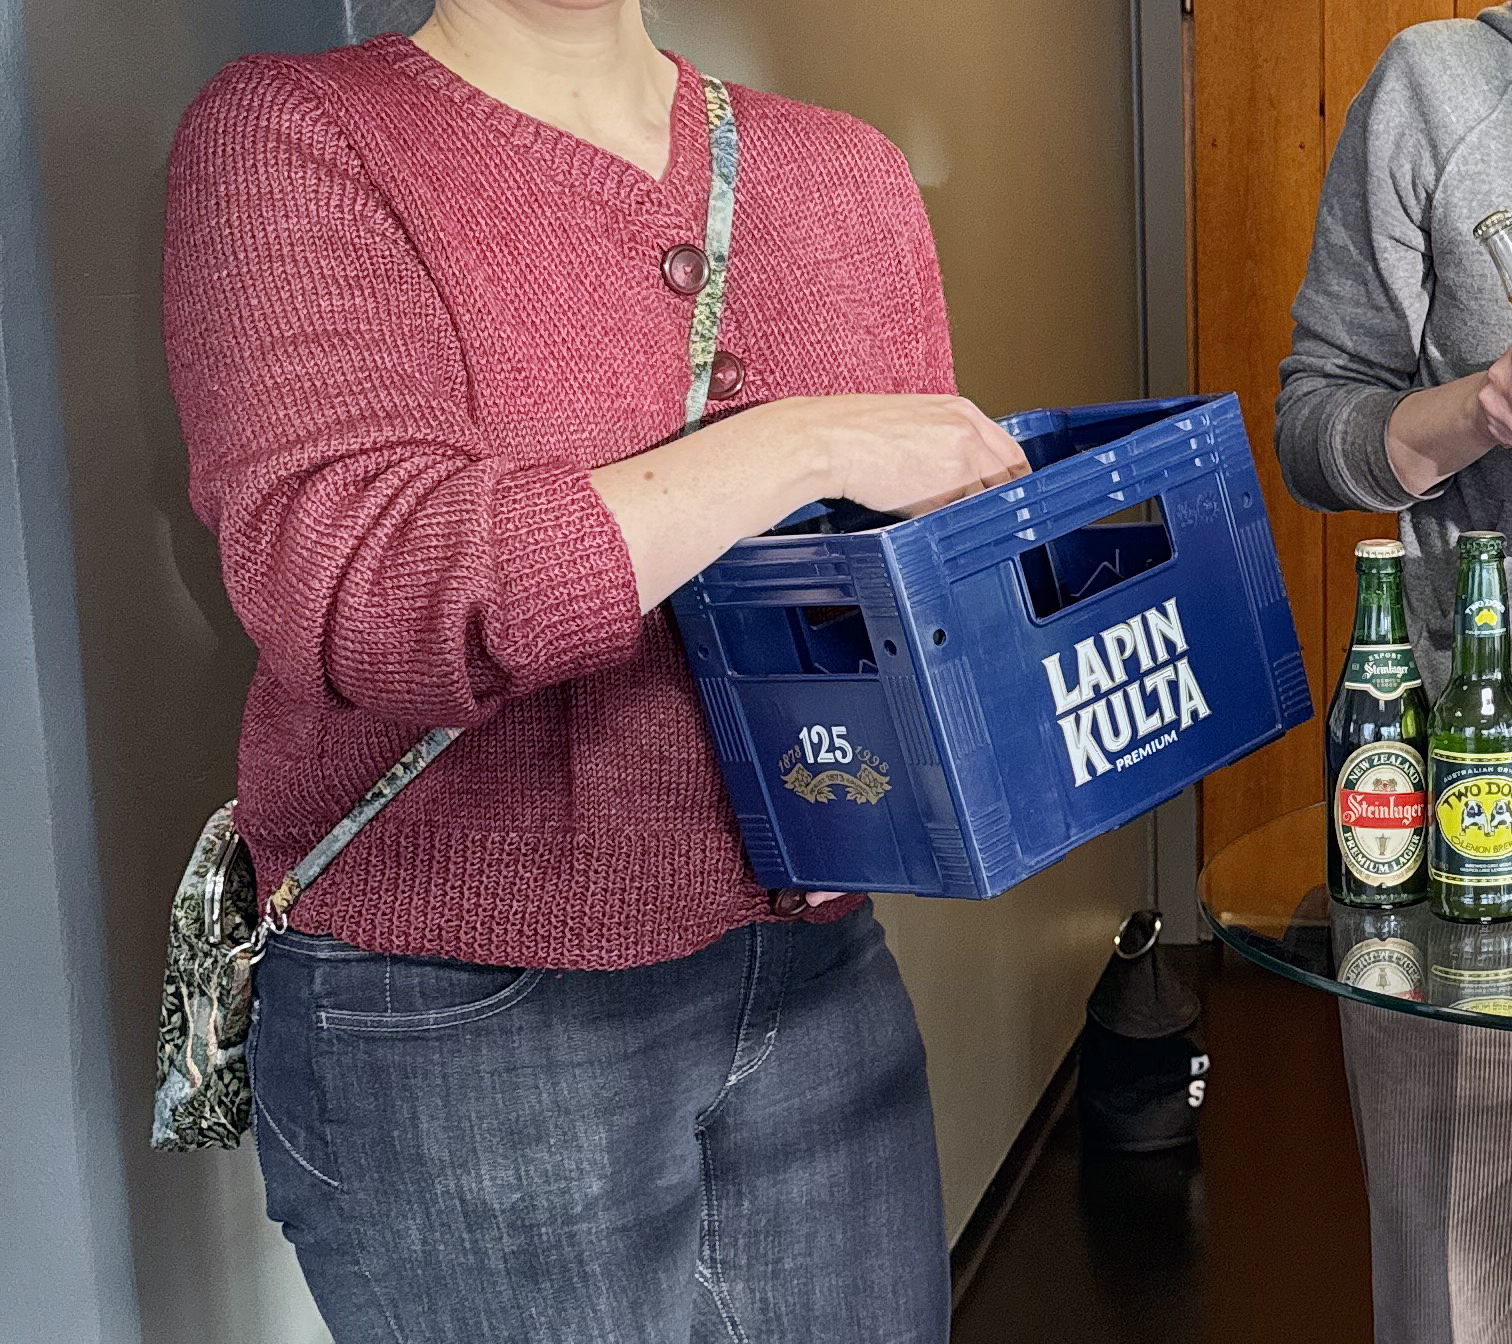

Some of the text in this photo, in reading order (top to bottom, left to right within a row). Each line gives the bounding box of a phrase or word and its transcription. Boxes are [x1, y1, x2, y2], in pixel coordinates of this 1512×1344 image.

[1041, 596, 1190, 716] LAPIN
[1362, 660, 1409, 680] Steinlager
[1056, 656, 1212, 787] KULTA
[798, 725, 853, 764] 125
[854, 745, 889, 773] 1998
[1115, 729, 1178, 772] PREMIUM
[1348, 753, 1420, 784] NEW ZEALAND
[1443, 766, 1495, 783] AUSTRALIAN
[1343, 793, 1423, 826] Steinlager
[1441, 783, 1482, 810] TWO
[1343, 831, 1390, 874] PREMIUM
[1391, 834, 1421, 871] LAGER
